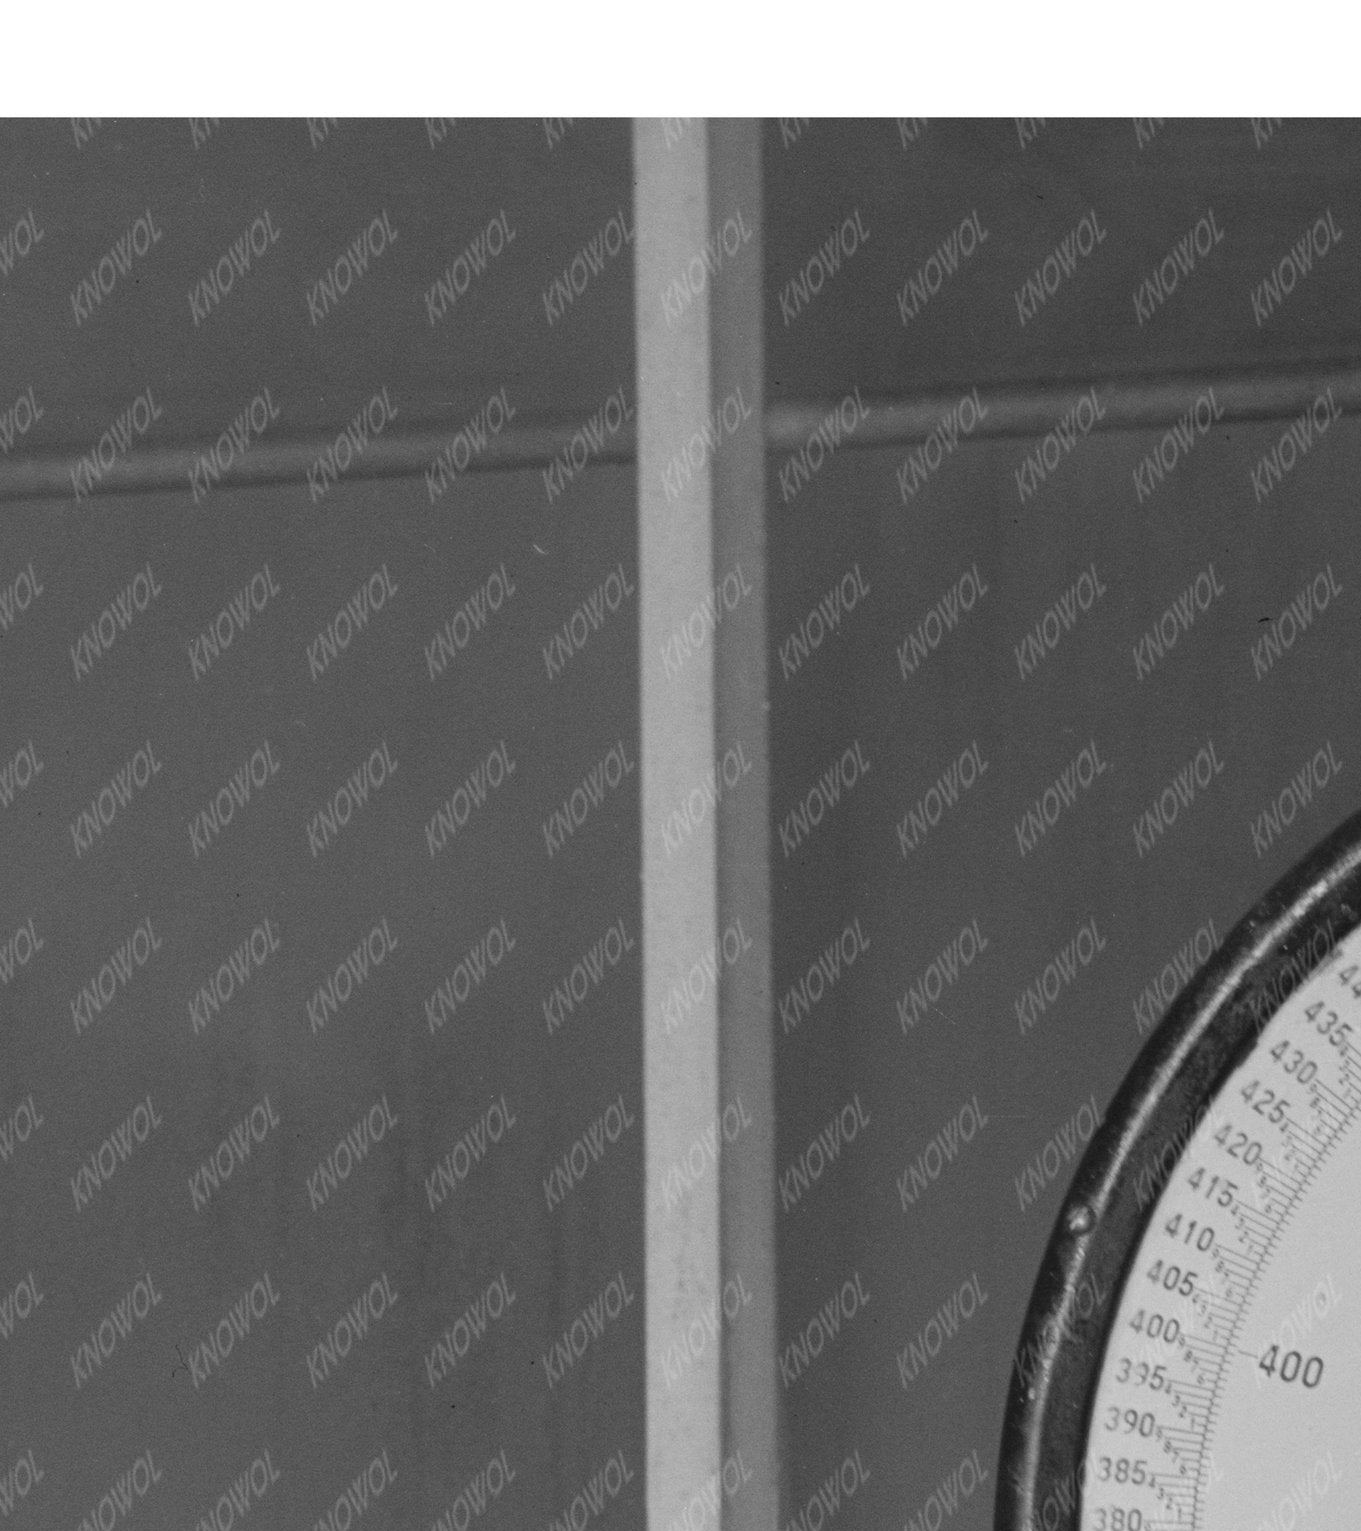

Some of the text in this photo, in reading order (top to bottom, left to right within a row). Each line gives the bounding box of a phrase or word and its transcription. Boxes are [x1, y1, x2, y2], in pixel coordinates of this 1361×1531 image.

[1303, 1001, 1352, 1046] 435
[1269, 1040, 1318, 1085] 430
[1240, 1080, 1290, 1124] 425
[1214, 1123, 1263, 1167] 420
[1187, 1167, 1238, 1207] 415
[1165, 1213, 1215, 1252] 410
[1146, 1259, 1199, 1298] 405
[1129, 1309, 1180, 1344] 400
[1116, 1358, 1167, 1391] 395
[1259, 1345, 1324, 1388] 400
[1104, 1406, 1156, 1439] 390
[1098, 1457, 1147, 1485] 385
